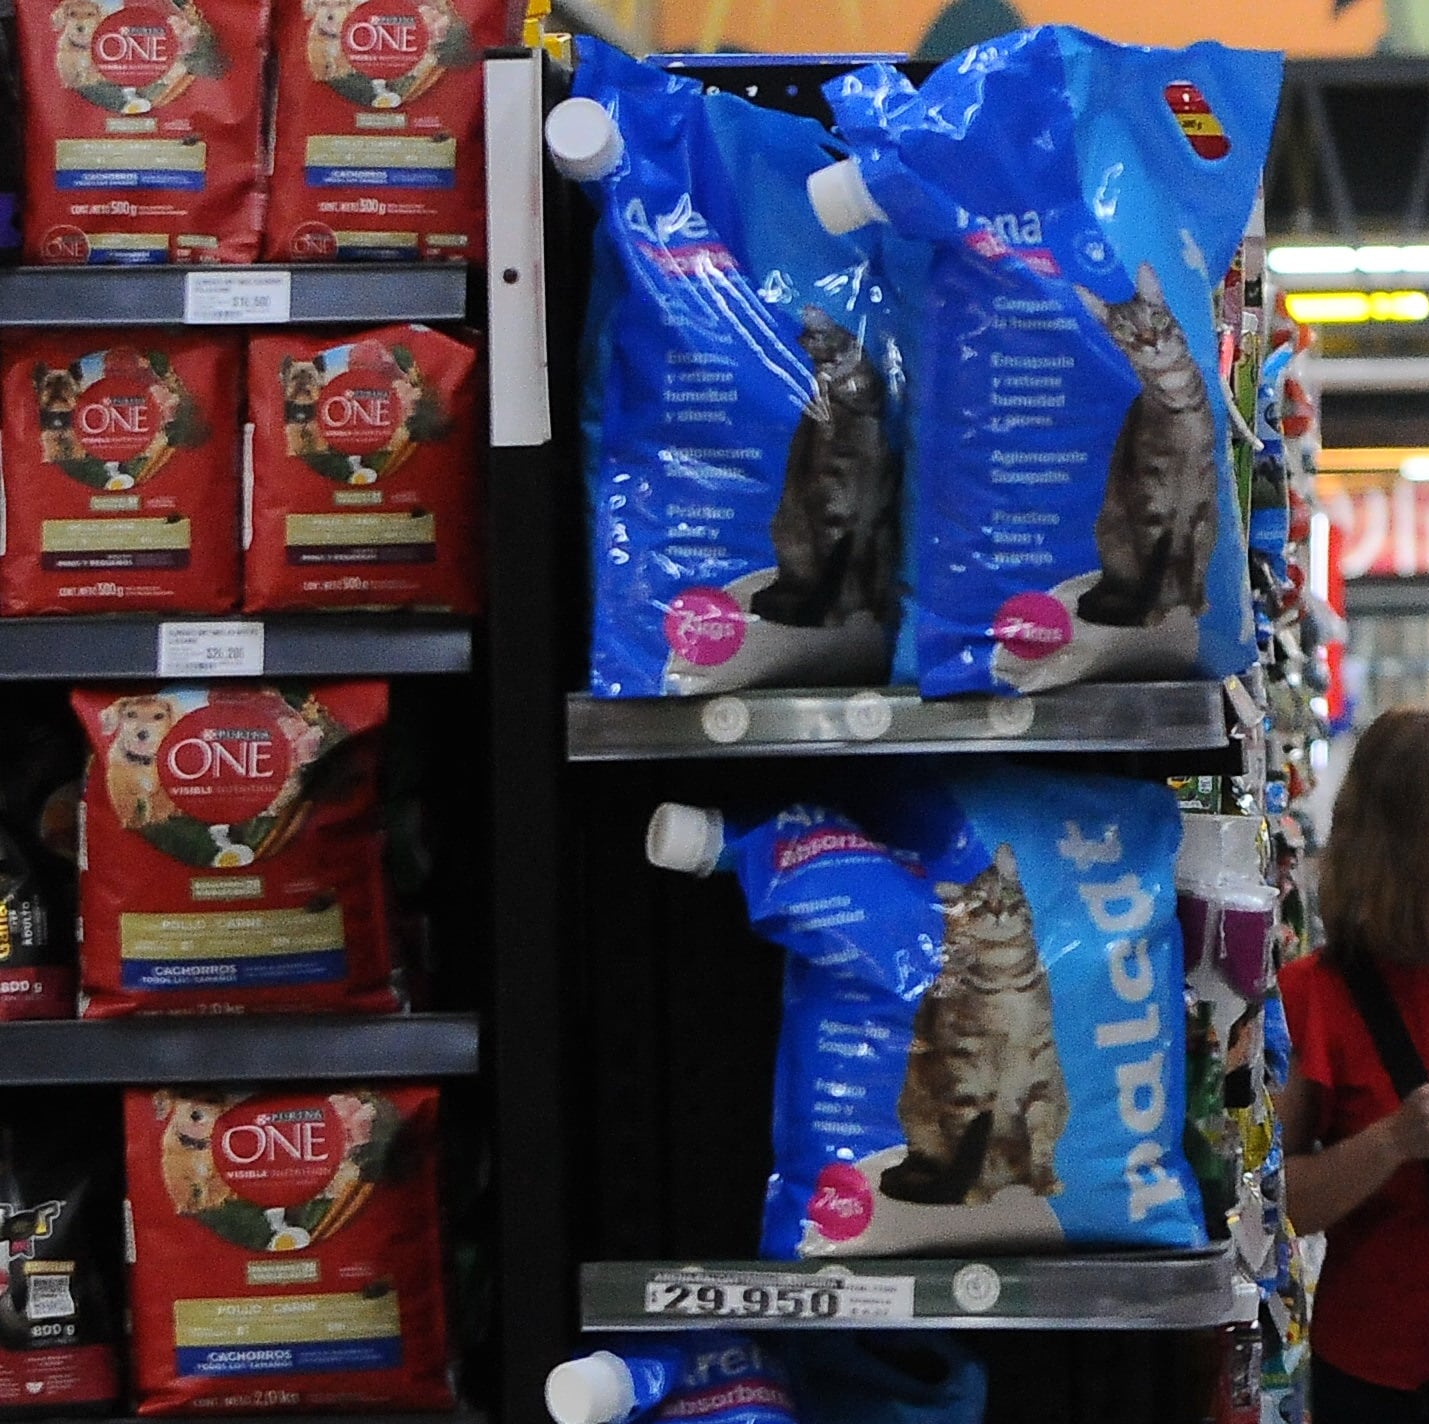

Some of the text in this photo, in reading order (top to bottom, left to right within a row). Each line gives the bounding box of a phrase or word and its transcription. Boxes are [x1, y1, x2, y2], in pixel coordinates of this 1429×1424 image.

[100, 33, 168, 62] ONE
[350, 22, 417, 51] ONE
[81, 404, 150, 434] ONE
[323, 396, 391, 428] ONE
[168, 738, 273, 781] ONE
[222, 1122, 329, 1164] ONE
[664, 1283, 840, 1318] 29.950
[208, 1350, 292, 1362] CACHORROS
